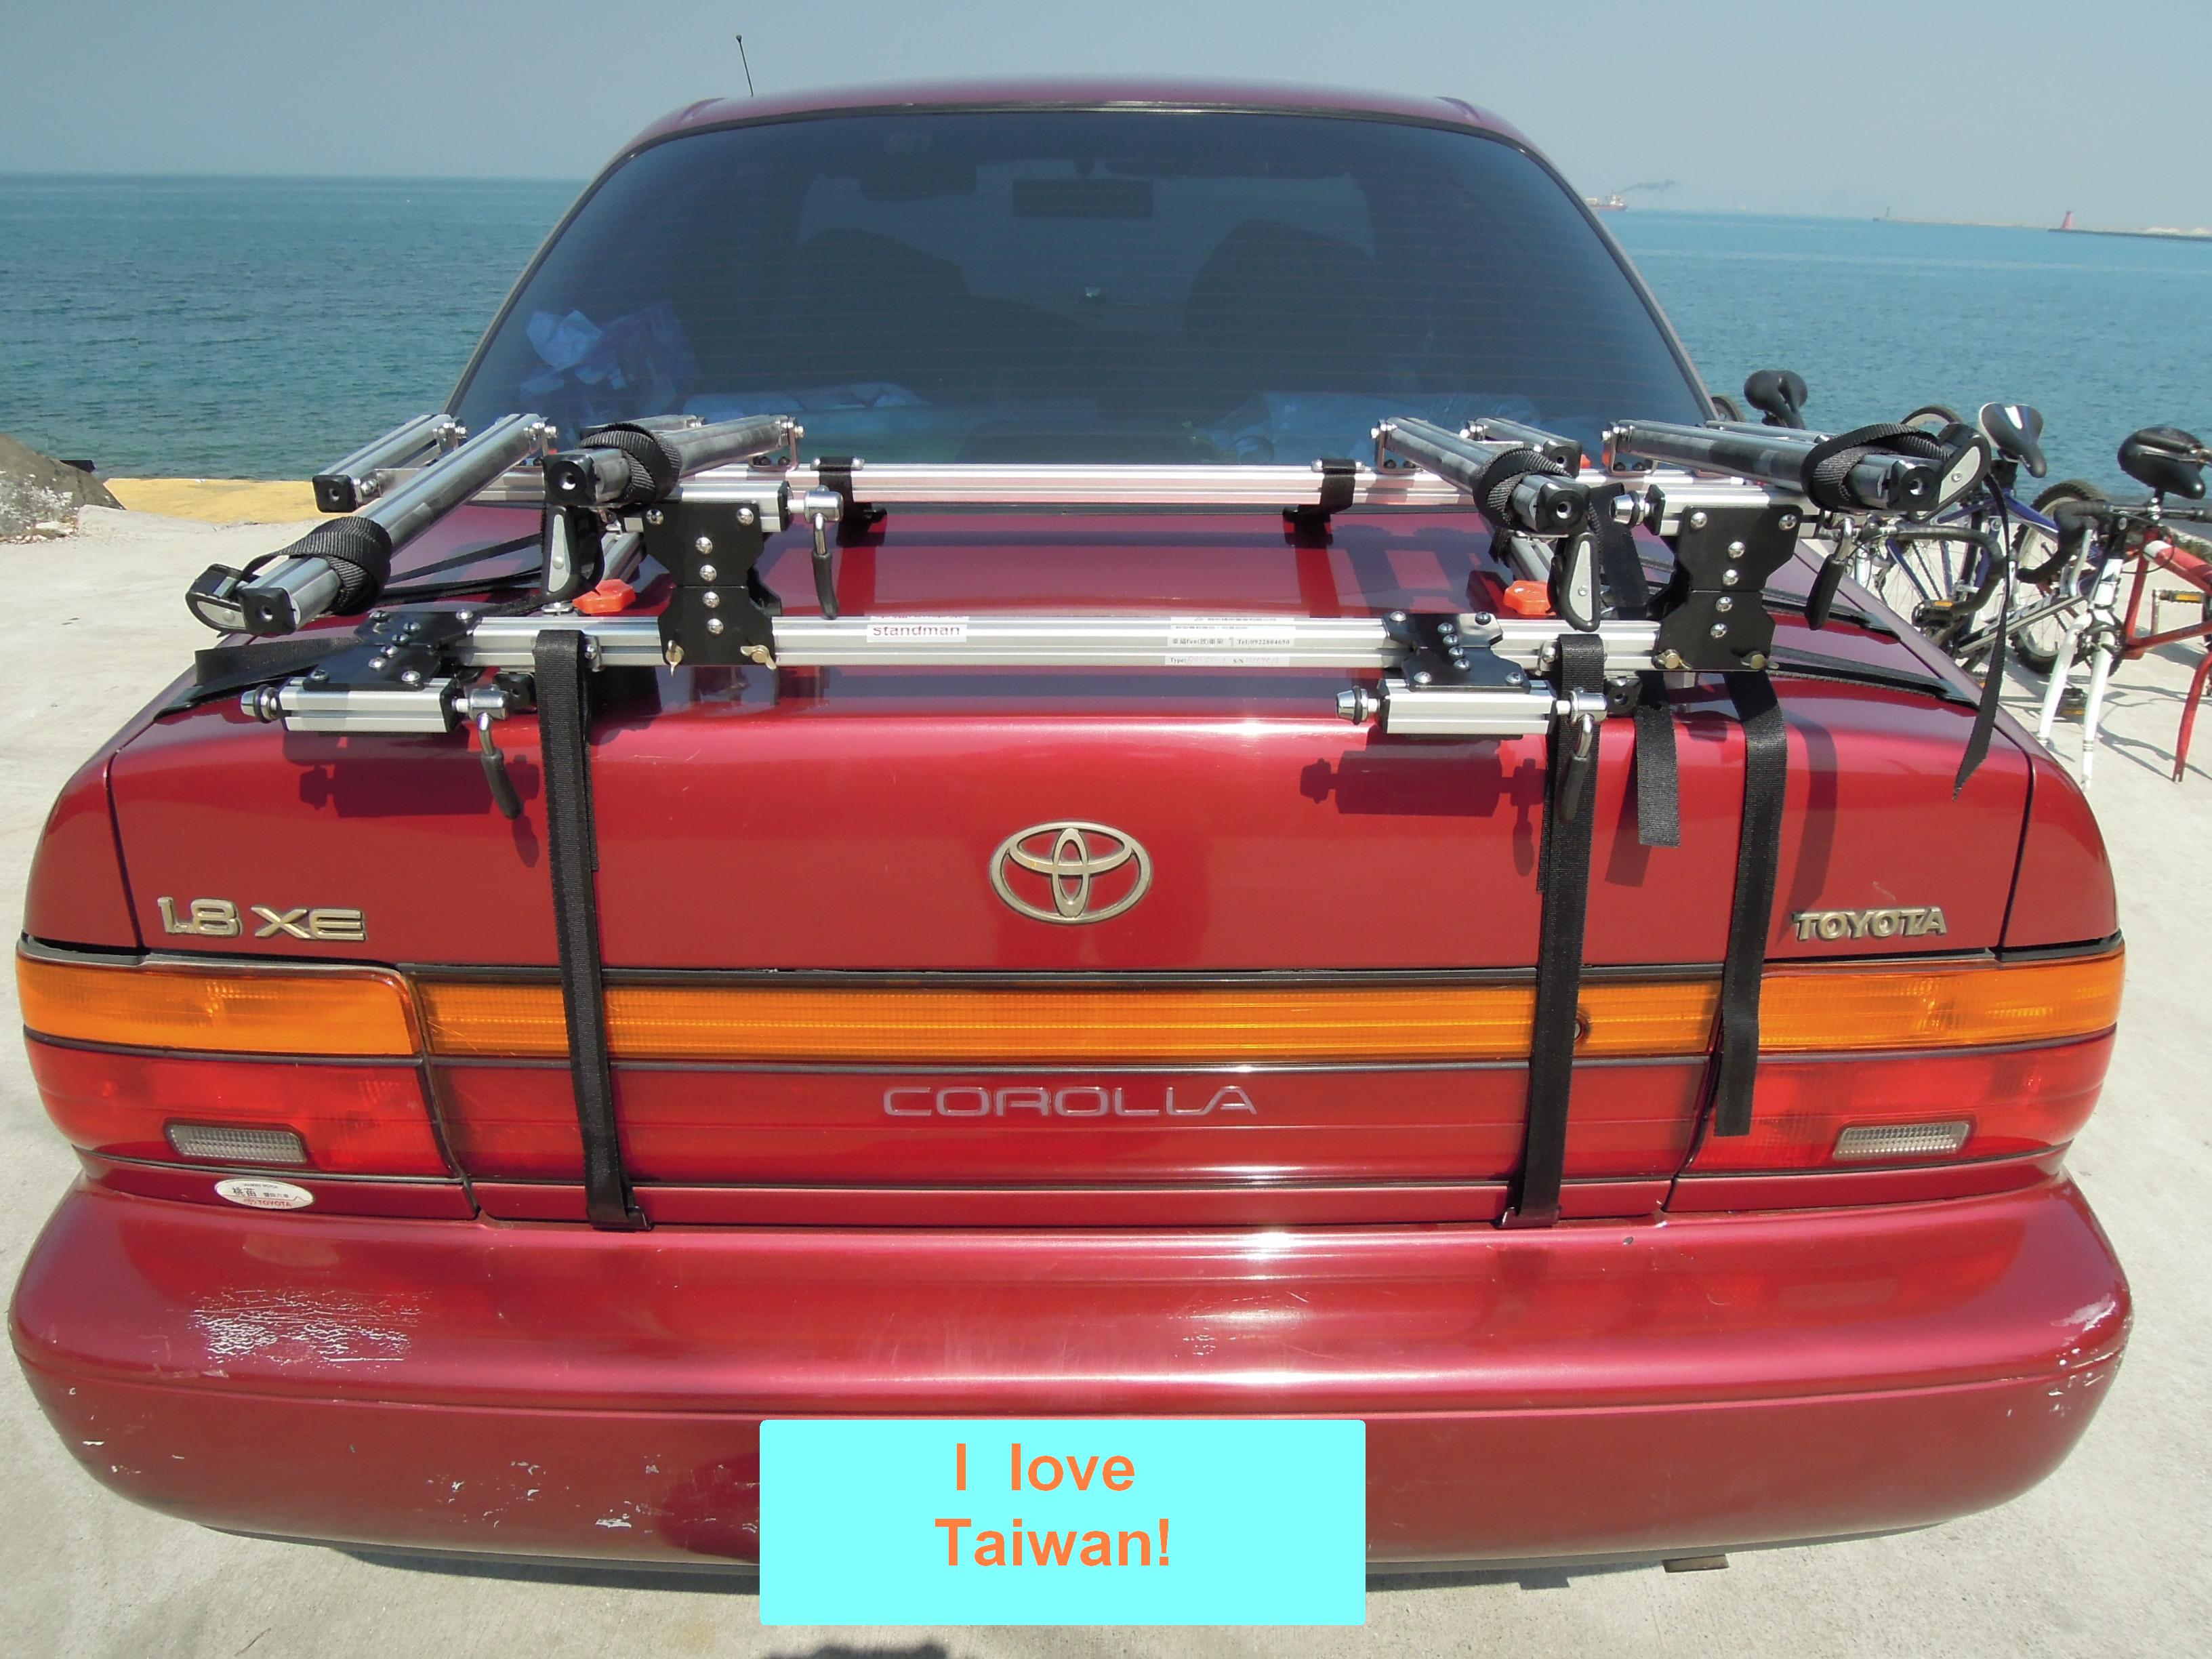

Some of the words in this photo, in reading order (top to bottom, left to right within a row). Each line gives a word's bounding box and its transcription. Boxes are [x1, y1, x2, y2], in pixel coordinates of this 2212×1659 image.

[873, 626, 960, 636] standman
[251, 906, 367, 941] XE
[1793, 906, 1948, 941] TOYOTA
[883, 1086, 1258, 1116] COROLLA
